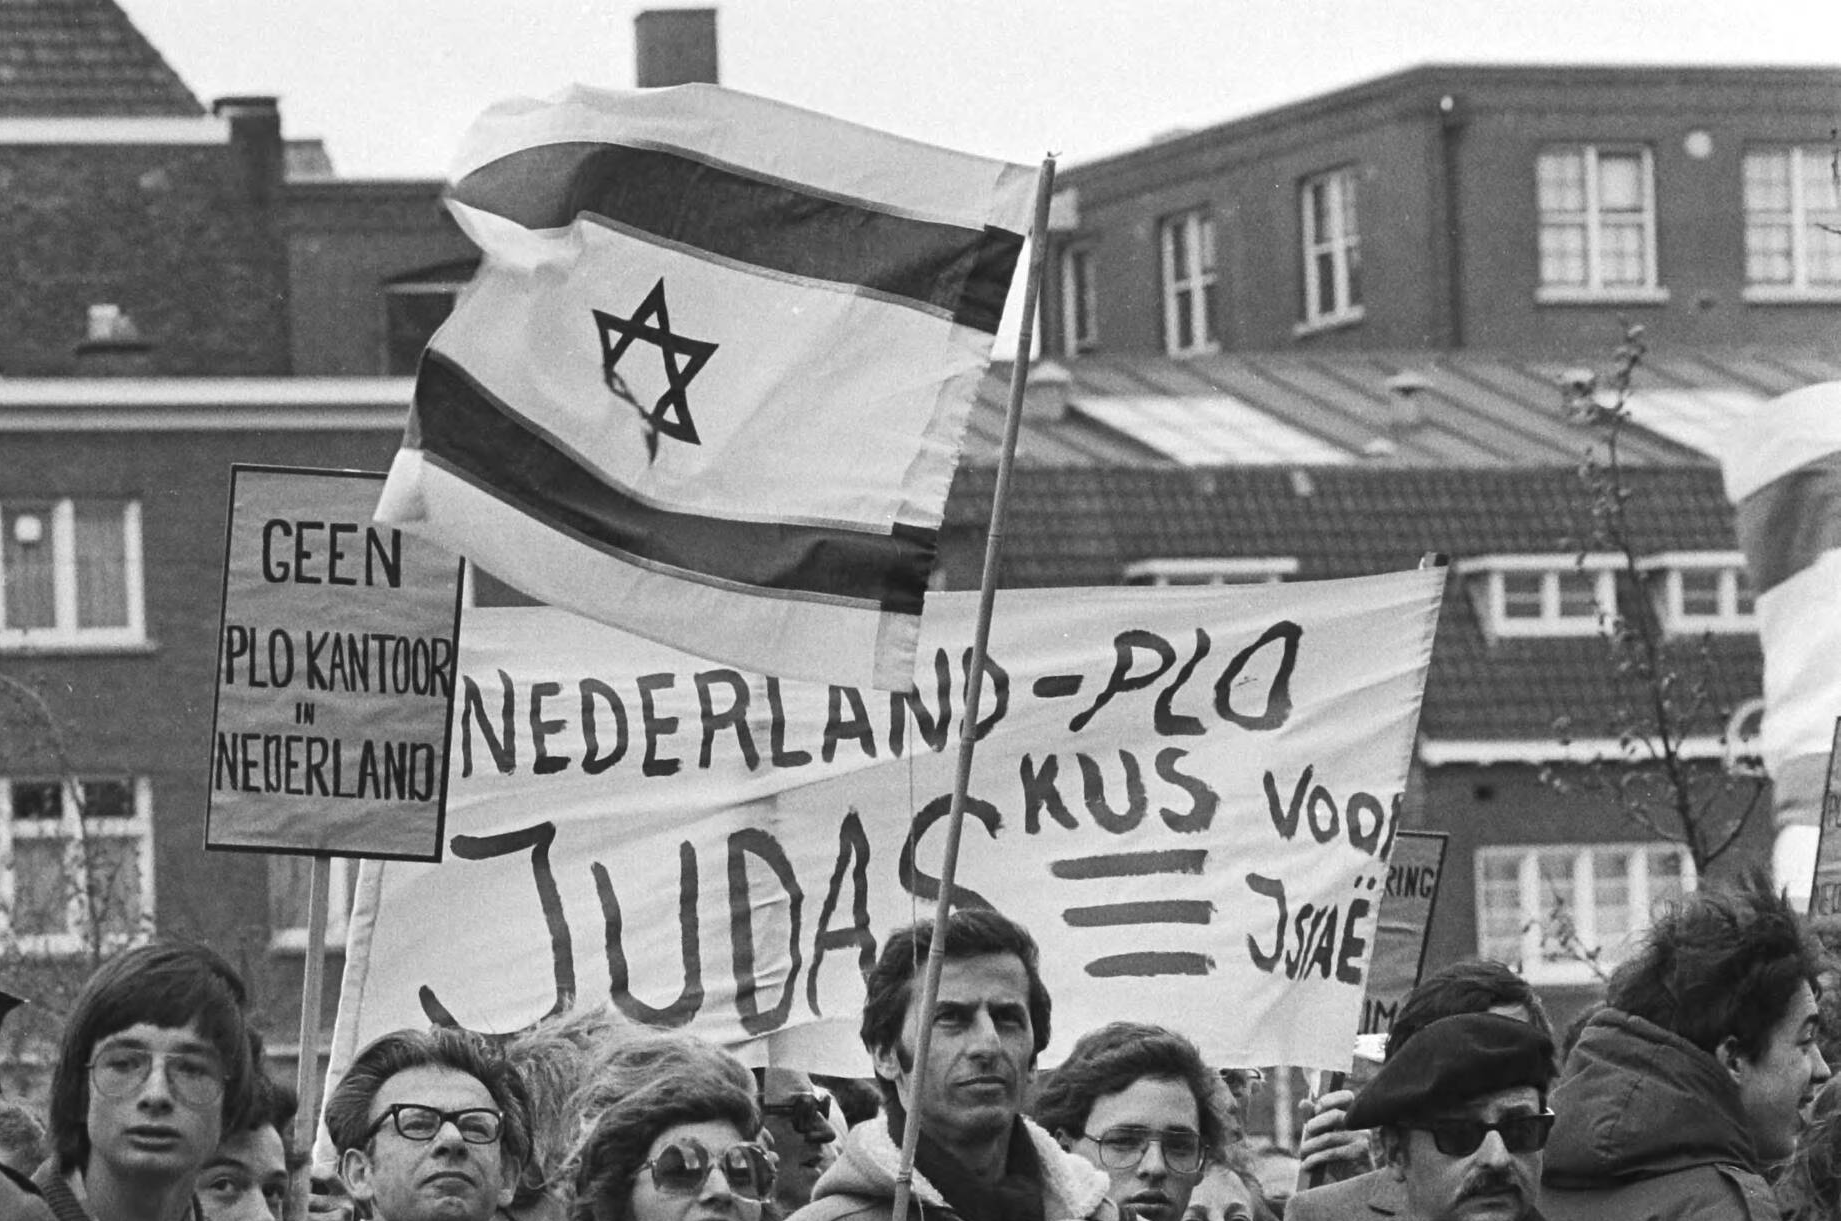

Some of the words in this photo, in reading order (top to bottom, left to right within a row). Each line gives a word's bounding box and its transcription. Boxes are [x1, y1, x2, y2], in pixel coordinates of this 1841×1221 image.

[262, 518, 401, 588] GEEN
[225, 624, 295, 688] PLO
[306, 630, 452, 697] KANTOOR
[295, 702, 315, 725] IN
[215, 731, 435, 801] NEDERLAND
